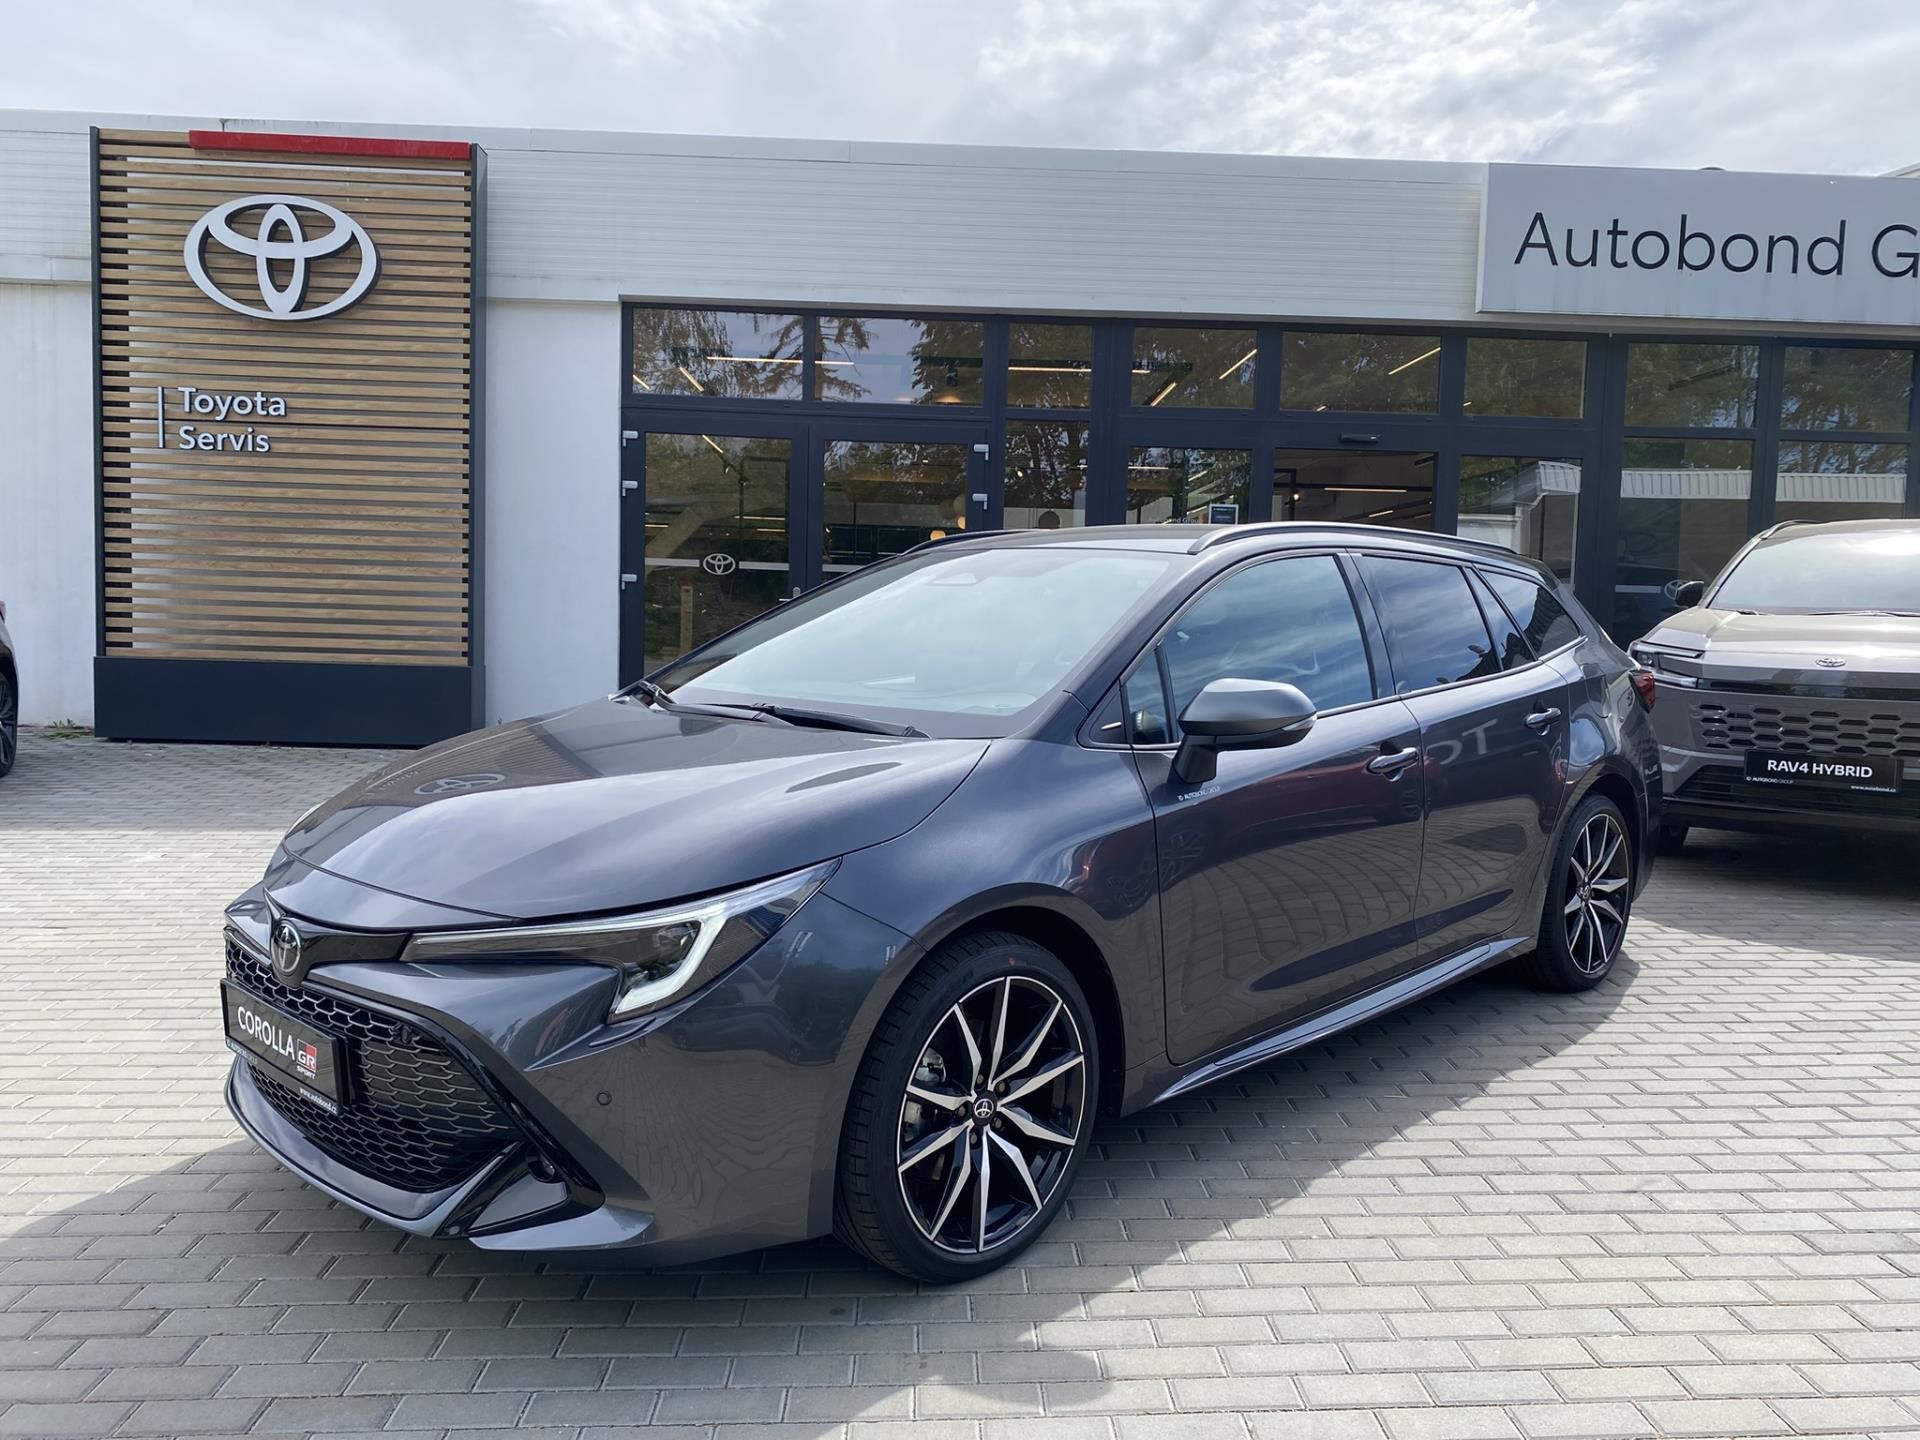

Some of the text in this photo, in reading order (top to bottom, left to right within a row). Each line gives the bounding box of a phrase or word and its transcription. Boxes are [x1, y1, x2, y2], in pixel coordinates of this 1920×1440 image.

[1514, 211, 1847, 276] Autobond
[177, 386, 286, 421] Toyota
[179, 425, 271, 453] Servis
[1767, 759, 1873, 778] RAV4 HYBRID
[237, 1006, 295, 1060] COROLLA
[298, 1050, 315, 1069] GR
